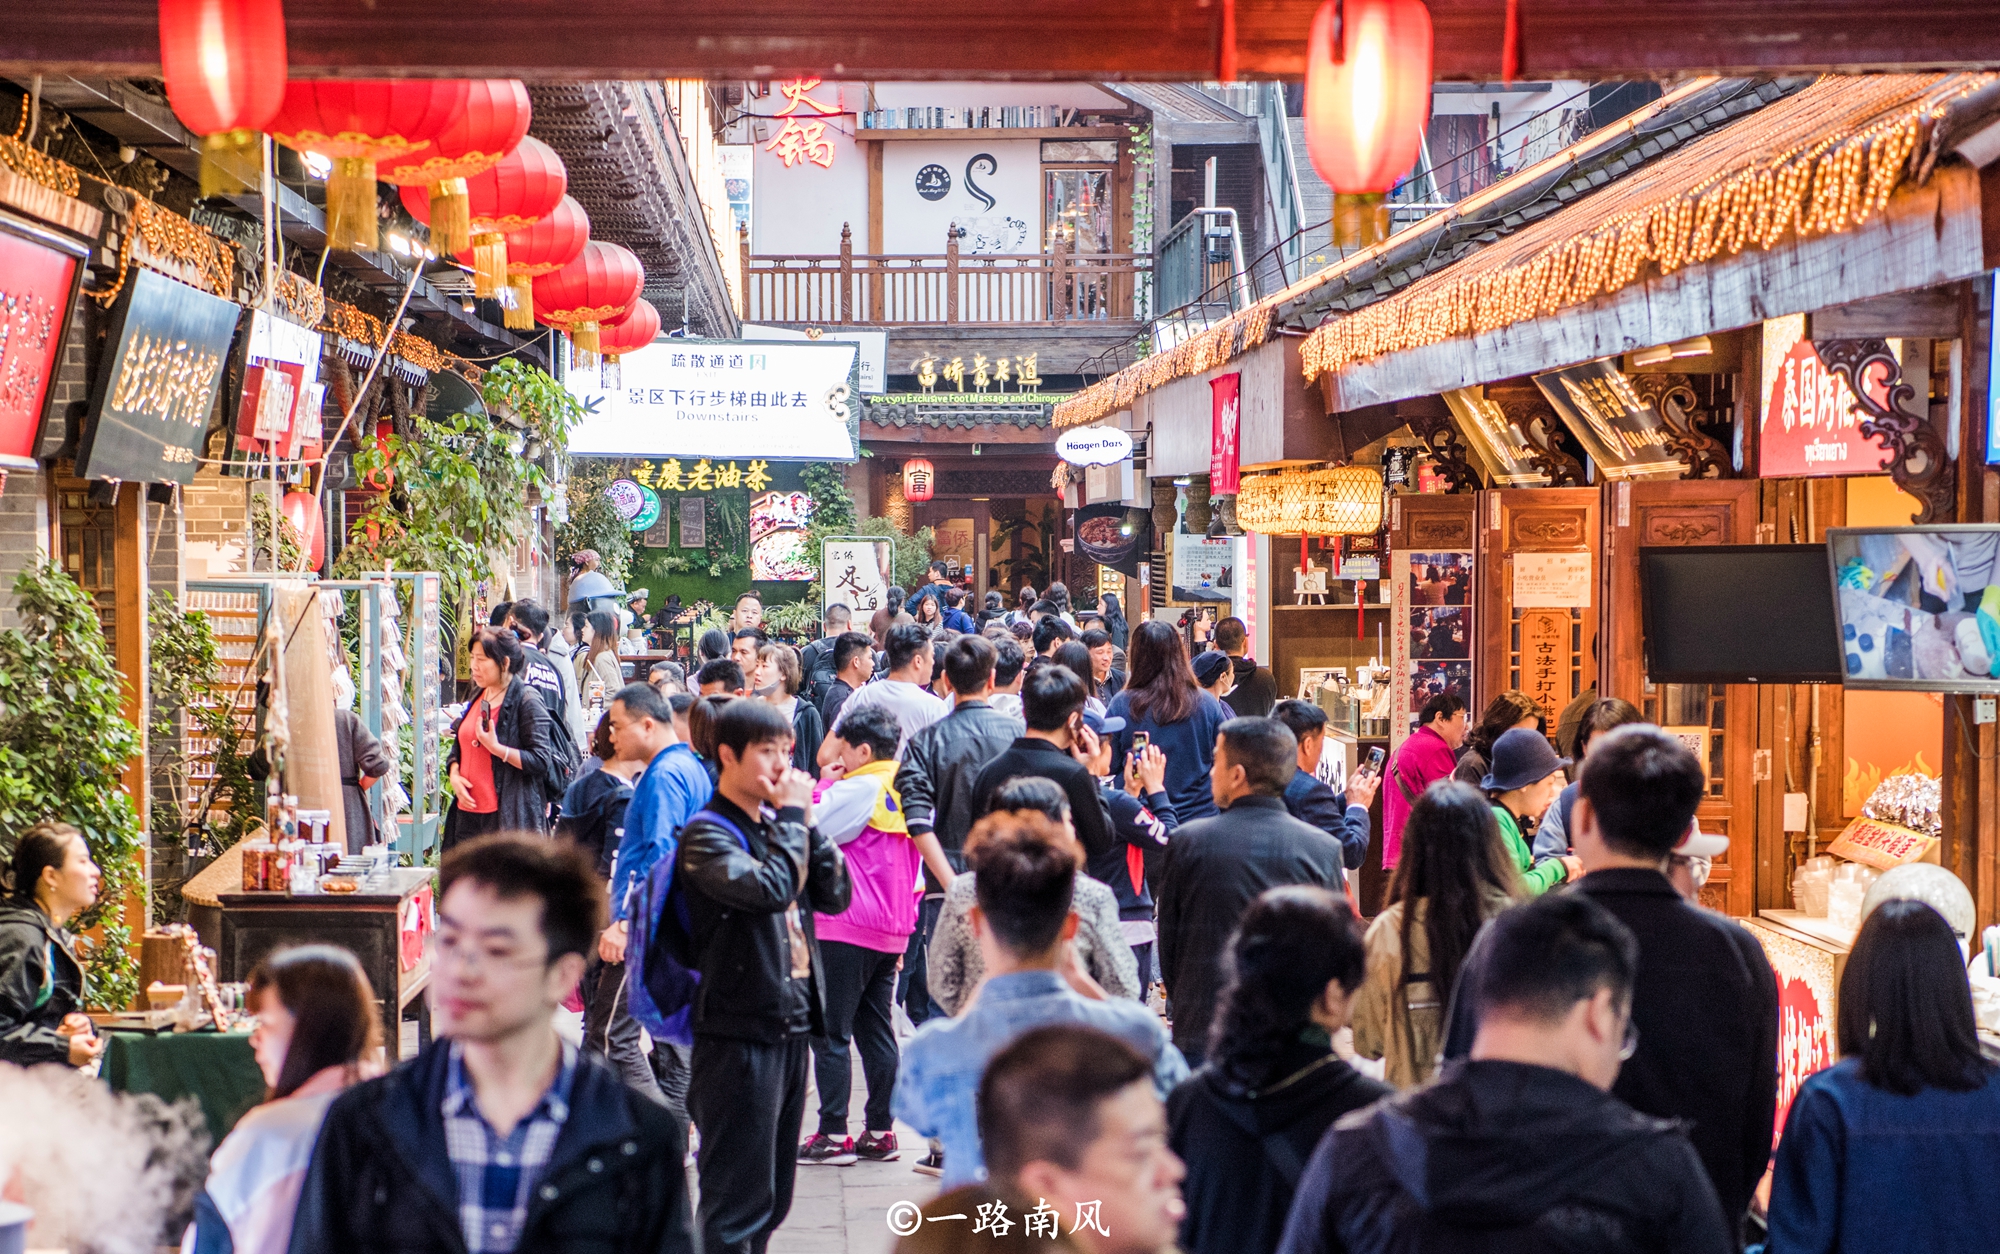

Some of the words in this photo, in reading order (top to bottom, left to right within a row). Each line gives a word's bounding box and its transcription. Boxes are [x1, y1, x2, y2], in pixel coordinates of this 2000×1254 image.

[767, 79, 842, 168] 火锅
[671, 354, 744, 369] 疏散通道
[628, 388, 808, 407] 景区下行步梯由此去
[907, 393, 948, 404] Exclusive
[949, 394, 969, 404] Foot
[970, 394, 1009, 405] Massage
[1010, 394, 1026, 404] and
[676, 410, 759, 422] Downstairs
[909, 469, 930, 494] 富
